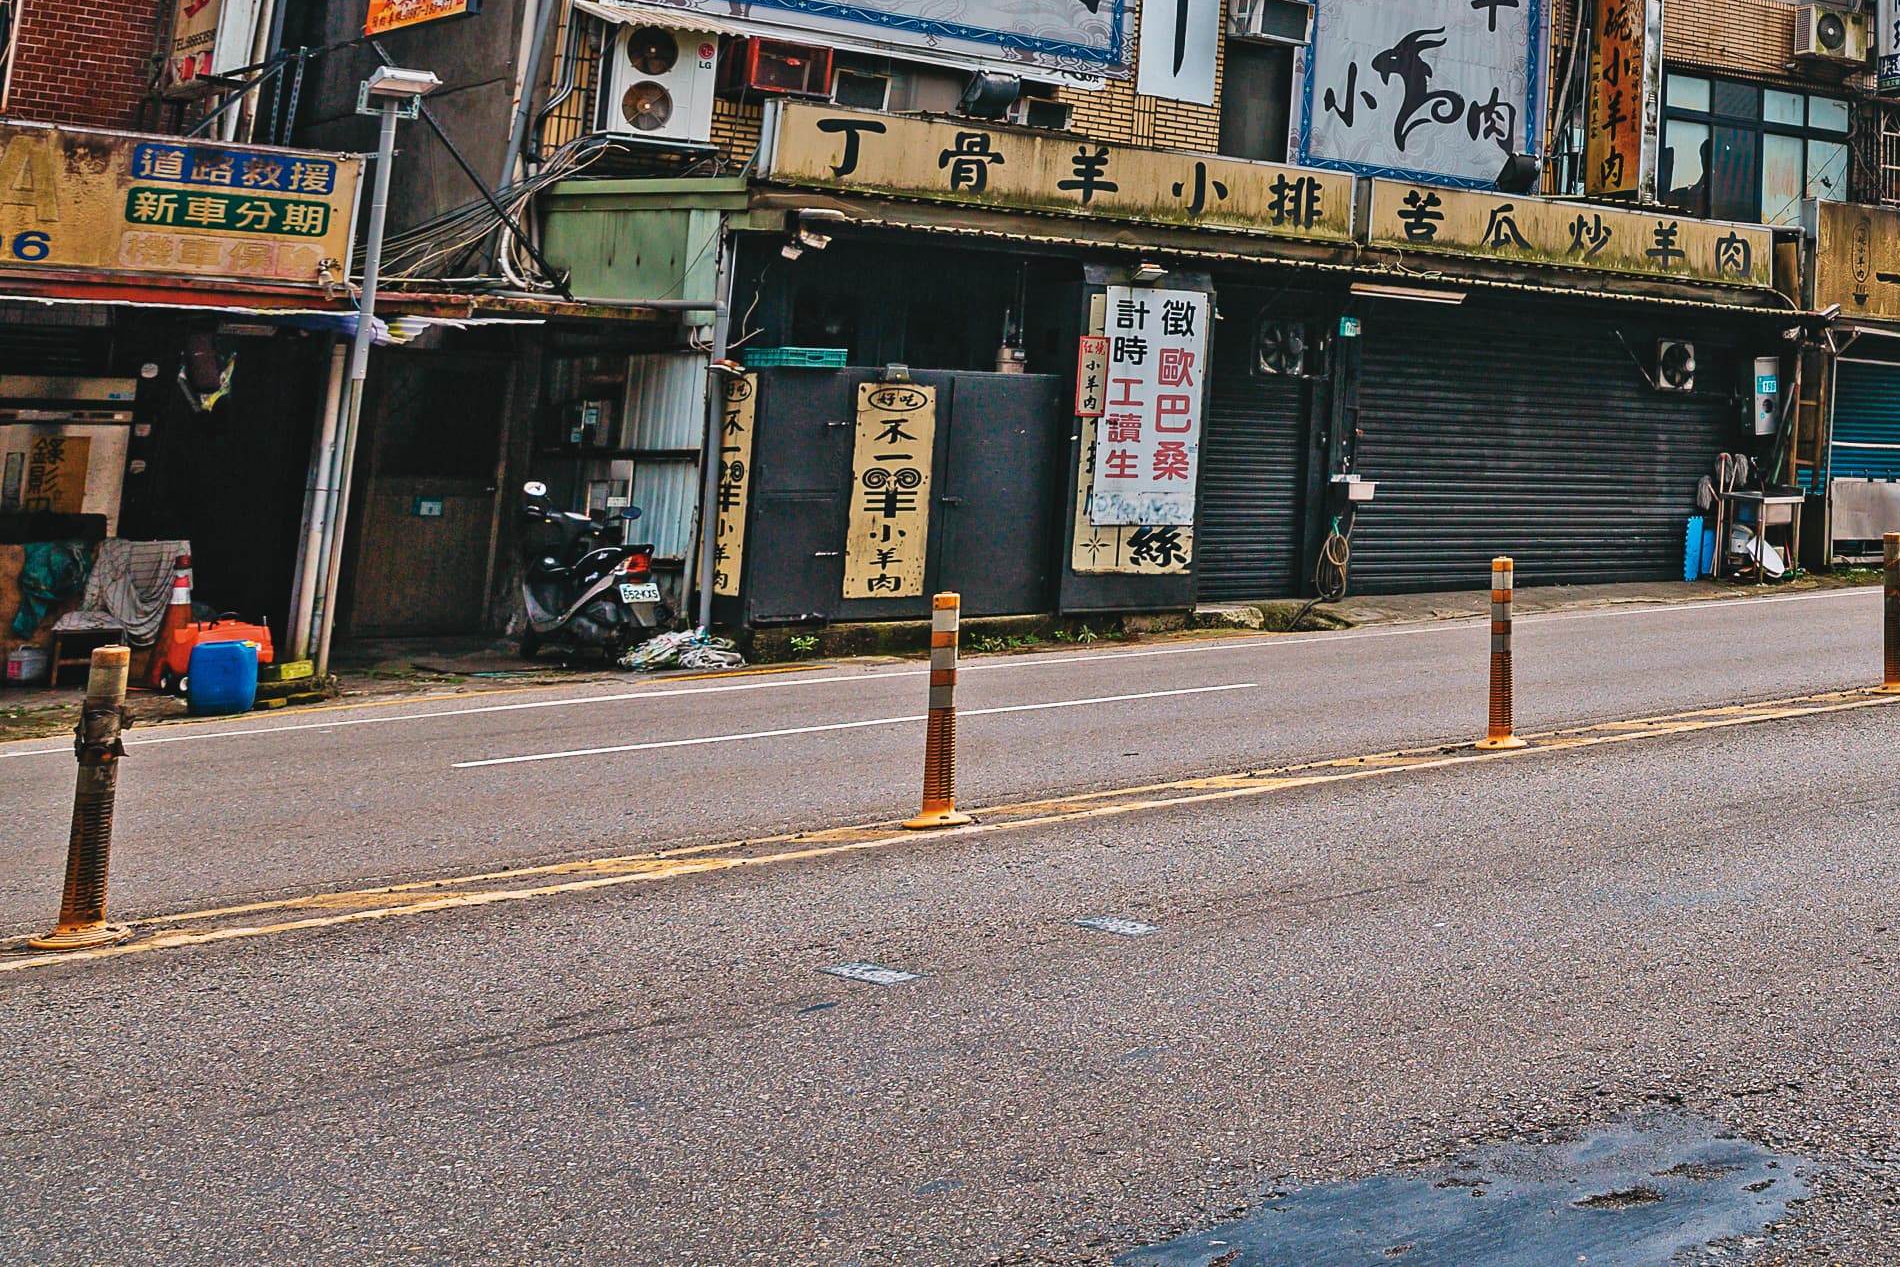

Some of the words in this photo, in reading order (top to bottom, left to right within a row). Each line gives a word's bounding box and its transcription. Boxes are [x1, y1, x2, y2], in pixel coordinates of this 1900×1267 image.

[698, 61, 712, 70] LG
[140, 146, 331, 193] 道路救援
[816, 117, 1323, 229] 丁骨羊小排
[133, 190, 324, 235] 新車分期
[1396, 190, 1752, 277] 苦瓜炒羊肉
[876, 391, 921, 408] 好吃
[1104, 299, 1151, 479] 計時工讀生
[1152, 299, 1197, 481] 徵歐巴桑
